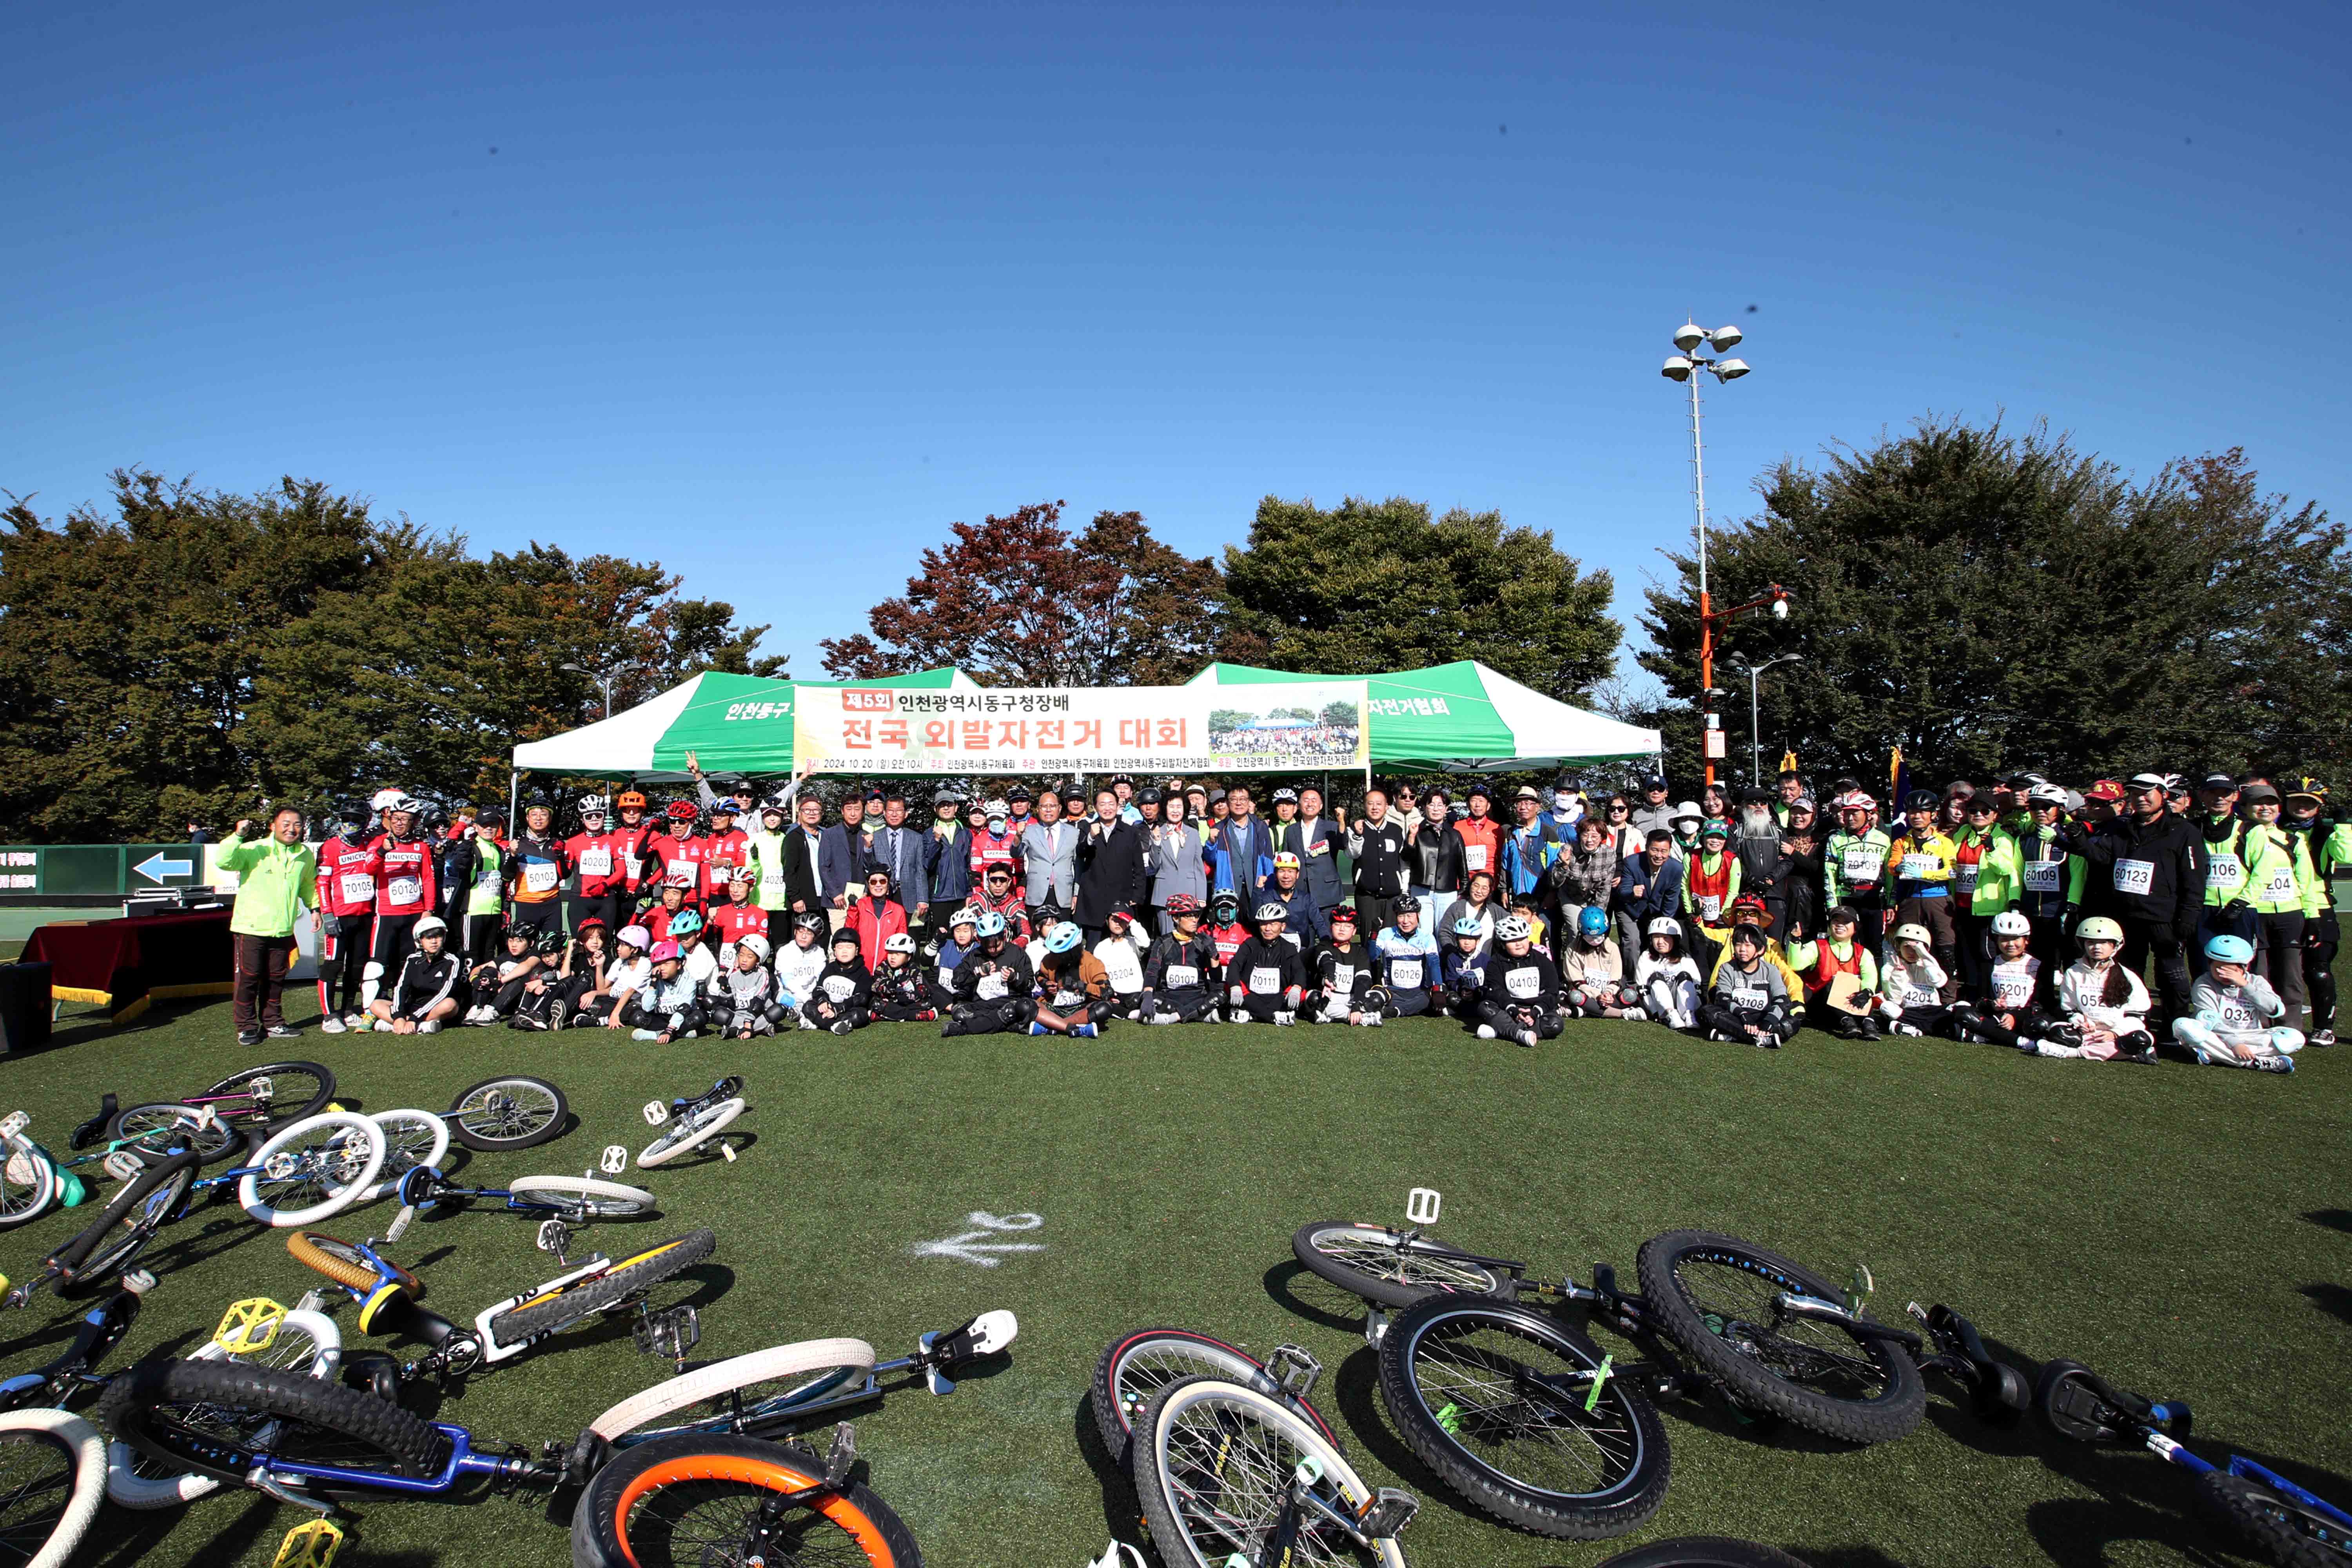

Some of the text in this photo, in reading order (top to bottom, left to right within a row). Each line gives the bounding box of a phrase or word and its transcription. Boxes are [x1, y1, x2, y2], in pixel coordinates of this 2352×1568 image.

[846, 693, 1069, 712] 제5회 인천광역시동구청장배
[724, 702, 791, 720] 인천동구
[842, 718, 1186, 750] 전국 외발자전거 대회
[947, 759, 1015, 769] 인천광역시동구체육회
[1041, 759, 1110, 769] 인천광역시동구체육회
[1113, 758, 1210, 769] 인천광역시동구외발자전거협회
[1236, 757, 1270, 768] 인천광역시
[1274, 757, 1287, 767] 동구
[1292, 755, 1354, 767] 한국외발자전거협회
[387, 853, 421, 862] UNICYCLE
[583, 857, 608, 867] 40203
[529, 872, 554, 882] 50102
[2025, 870, 2056, 881] 60109
[2115, 867, 2148, 883] 60123
[345, 881, 373, 894] 70105
[391, 884, 418, 896] 60120
[793, 966, 814, 977] 06101
[1108, 968, 1134, 981] 05204
[1394, 969, 1420, 980] 60126
[1169, 974, 1195, 985] 60107
[1252, 975, 1276, 986] 70111
[1509, 977, 1537, 989] 04103
[825, 982, 851, 997] 03104
[1994, 982, 2026, 996] 05201
